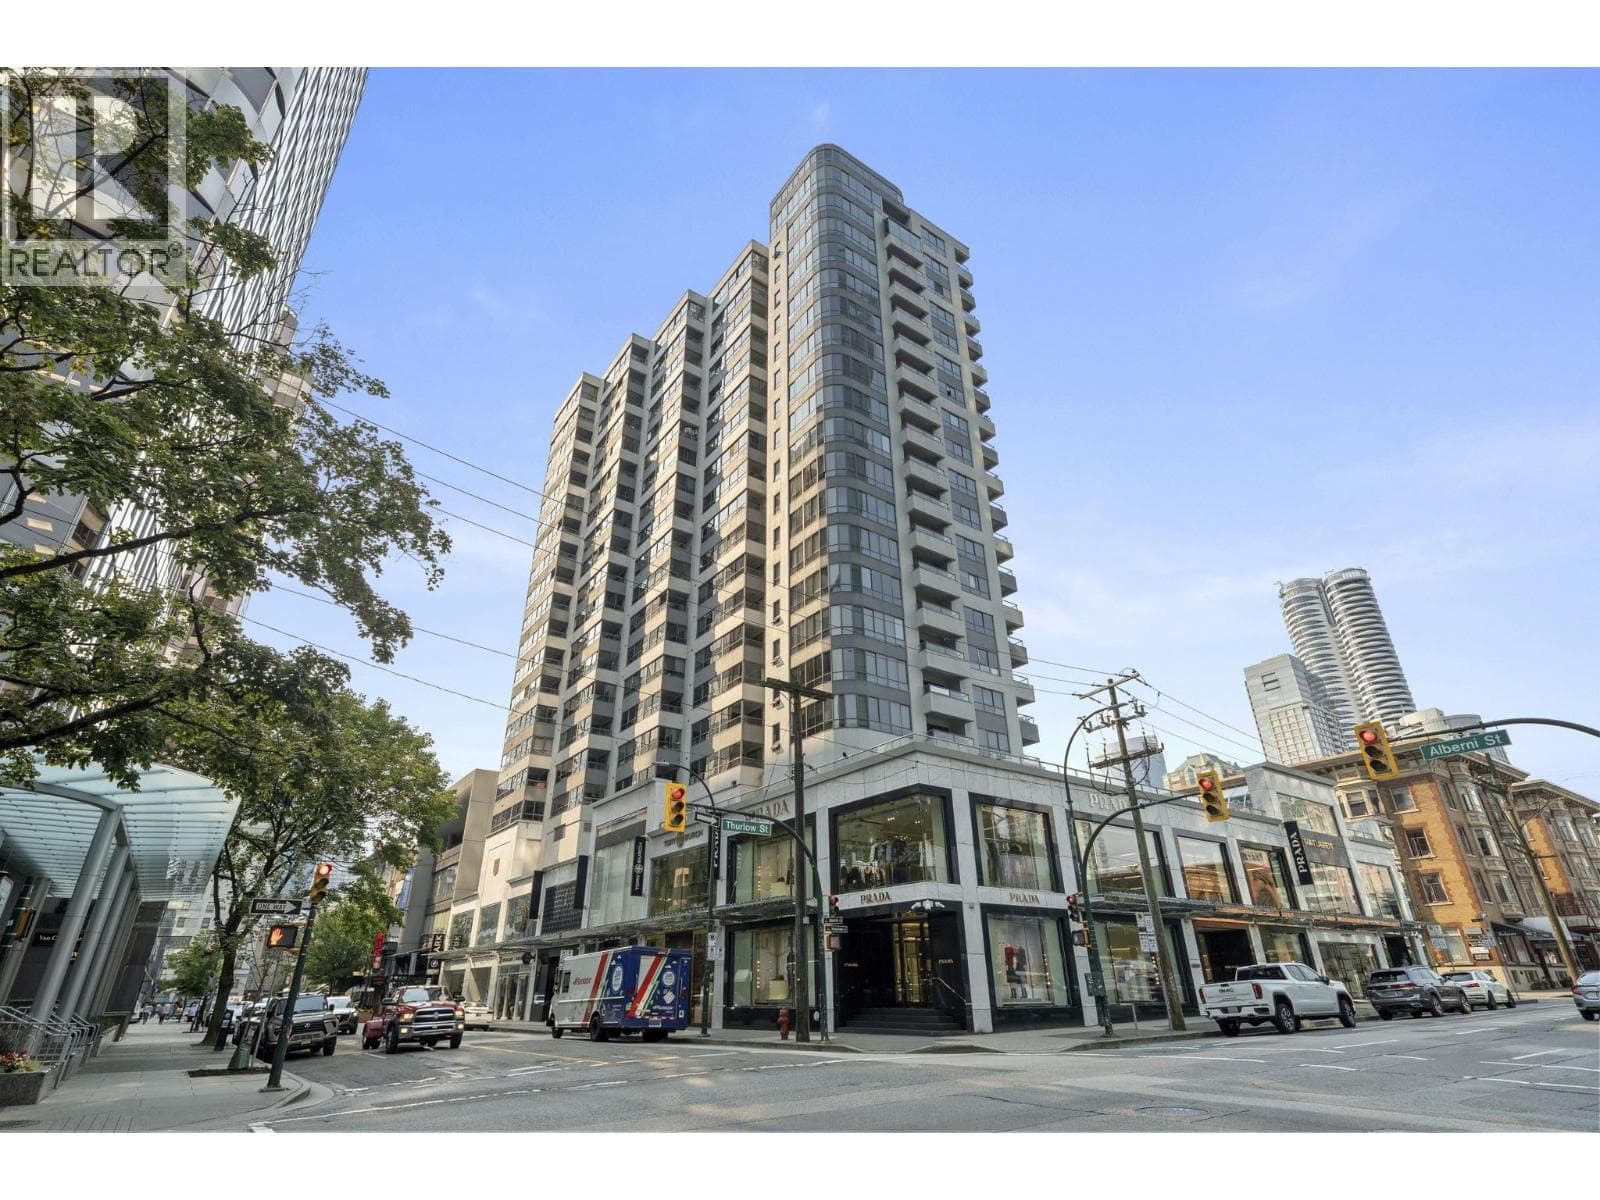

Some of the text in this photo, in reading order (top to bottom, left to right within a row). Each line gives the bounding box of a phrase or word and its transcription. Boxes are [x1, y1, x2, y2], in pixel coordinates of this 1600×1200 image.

[1430, 733, 1504, 757] Alberni St
[1090, 793, 1128, 811] PRAD
[726, 820, 770, 834] Thurlow St
[1290, 831, 1308, 873] PRADA
[860, 891, 892, 905] PRADA
[1010, 892, 1041, 904] PRADA
[257, 902, 271, 911] ONE
